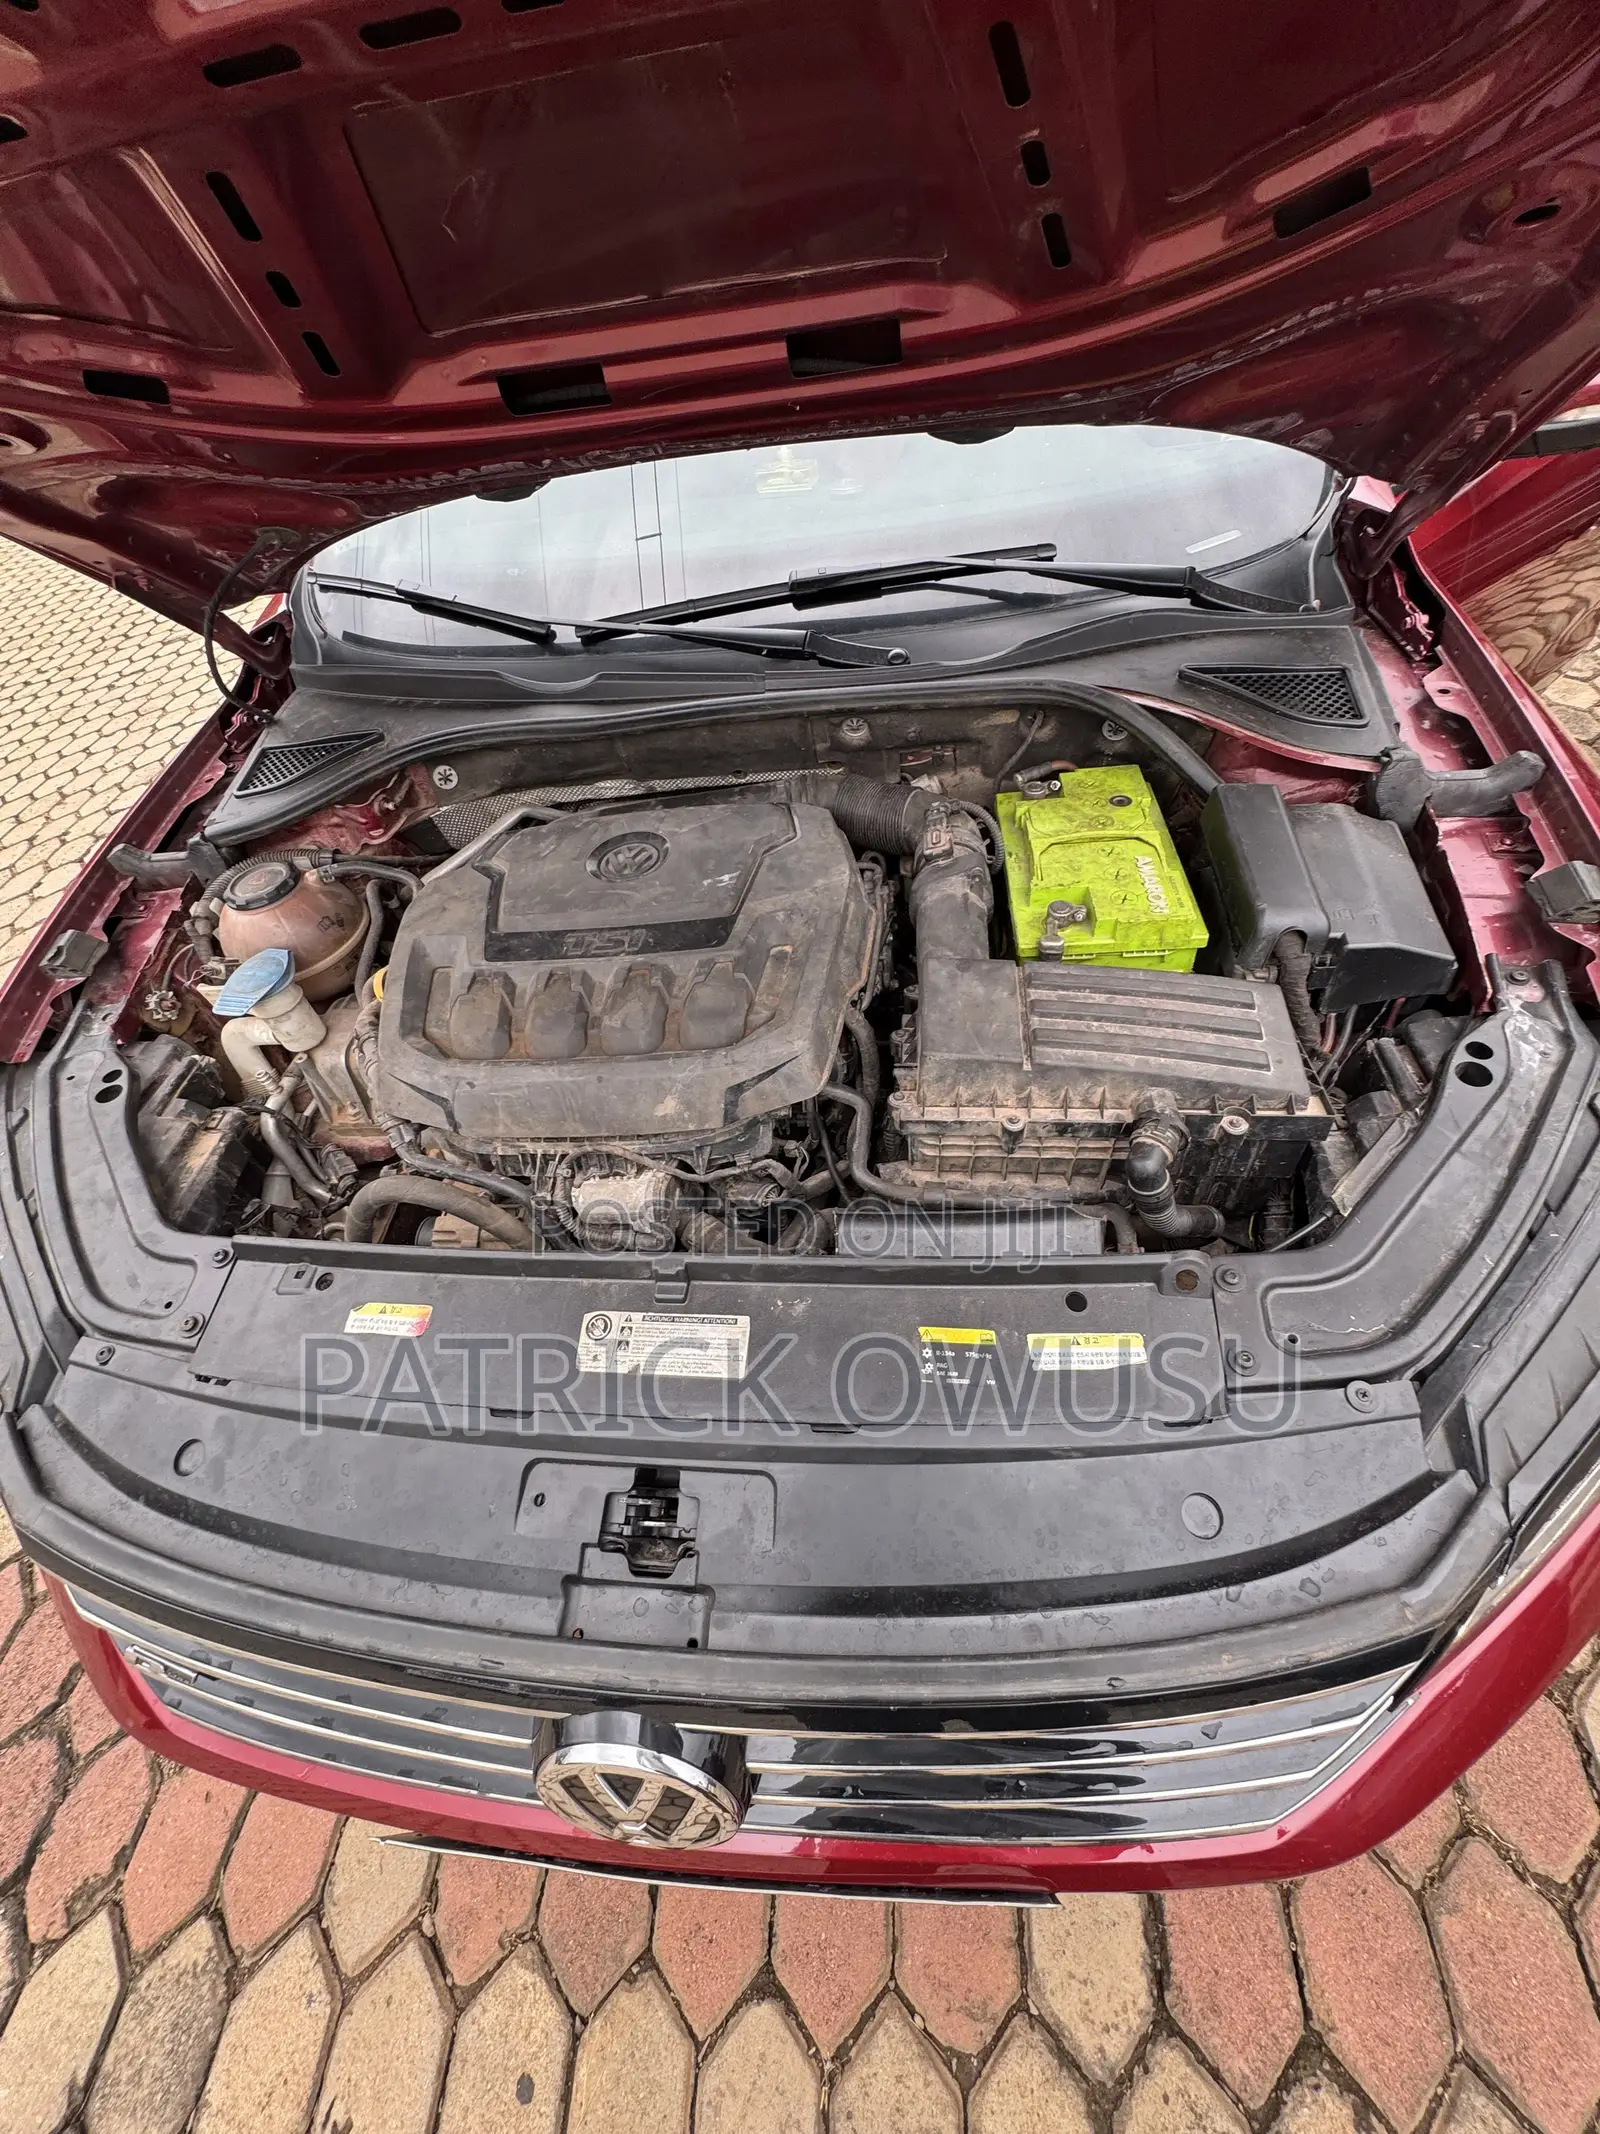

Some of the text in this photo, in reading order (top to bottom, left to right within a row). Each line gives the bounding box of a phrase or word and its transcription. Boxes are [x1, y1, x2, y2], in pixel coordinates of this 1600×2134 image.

[1134, 855, 1170, 914] AMARON
[563, 928, 648, 956] TSI
[1084, 1336, 1100, 1345] 경고
